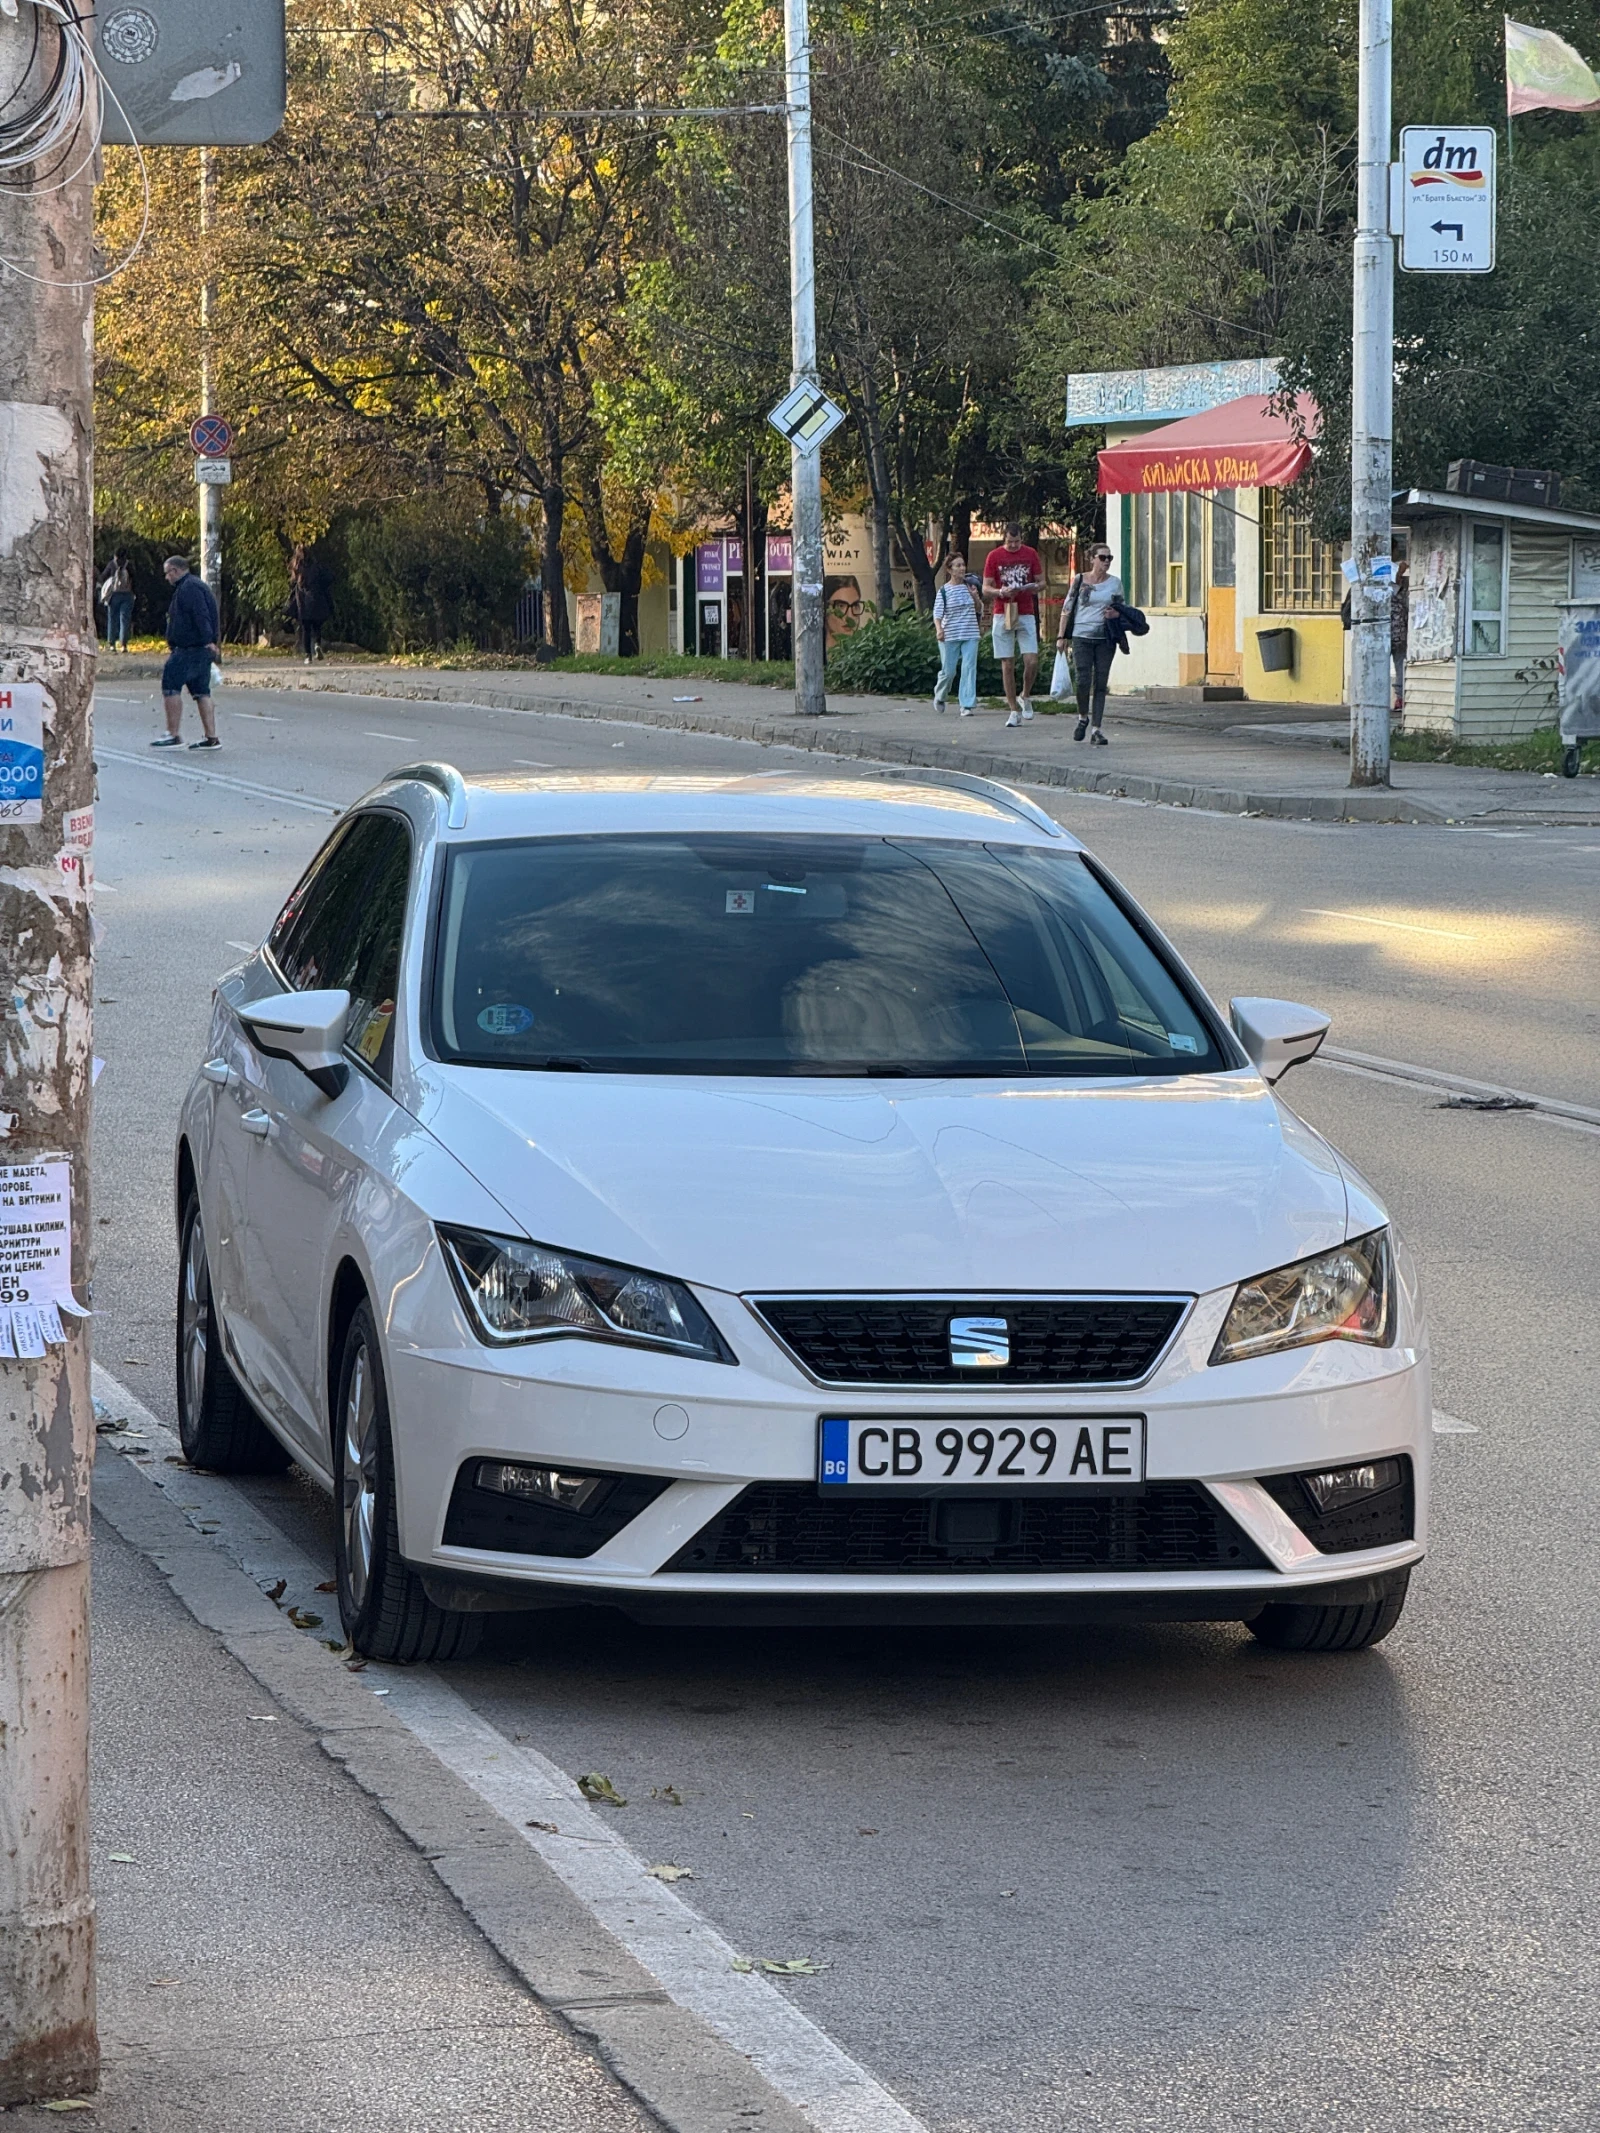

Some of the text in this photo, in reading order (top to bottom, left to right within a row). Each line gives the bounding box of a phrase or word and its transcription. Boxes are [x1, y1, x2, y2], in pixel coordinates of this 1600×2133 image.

[1423, 136, 1477, 169] dm
[1433, 250, 1458, 262] 150
[1214, 457, 1258, 483] ХРАНА
[13, 1167, 47, 1178] МАЗЕТА,
[0, 1181, 33, 1192] ОРОВЕ,
[3, 1197, 15, 1206] НА
[19, 1193, 55, 1205] ВИТРИНИ
[54, 1247, 60, 1256] И
[15, 1261, 45, 1274] ЦЕНИ.
[0, 1276, 19, 1290] ЕН
[0, 1289, 29, 1303] 99
[858, 1427, 1132, 1476] CB 9929 AE
[825, 1461, 846, 1475] BG
